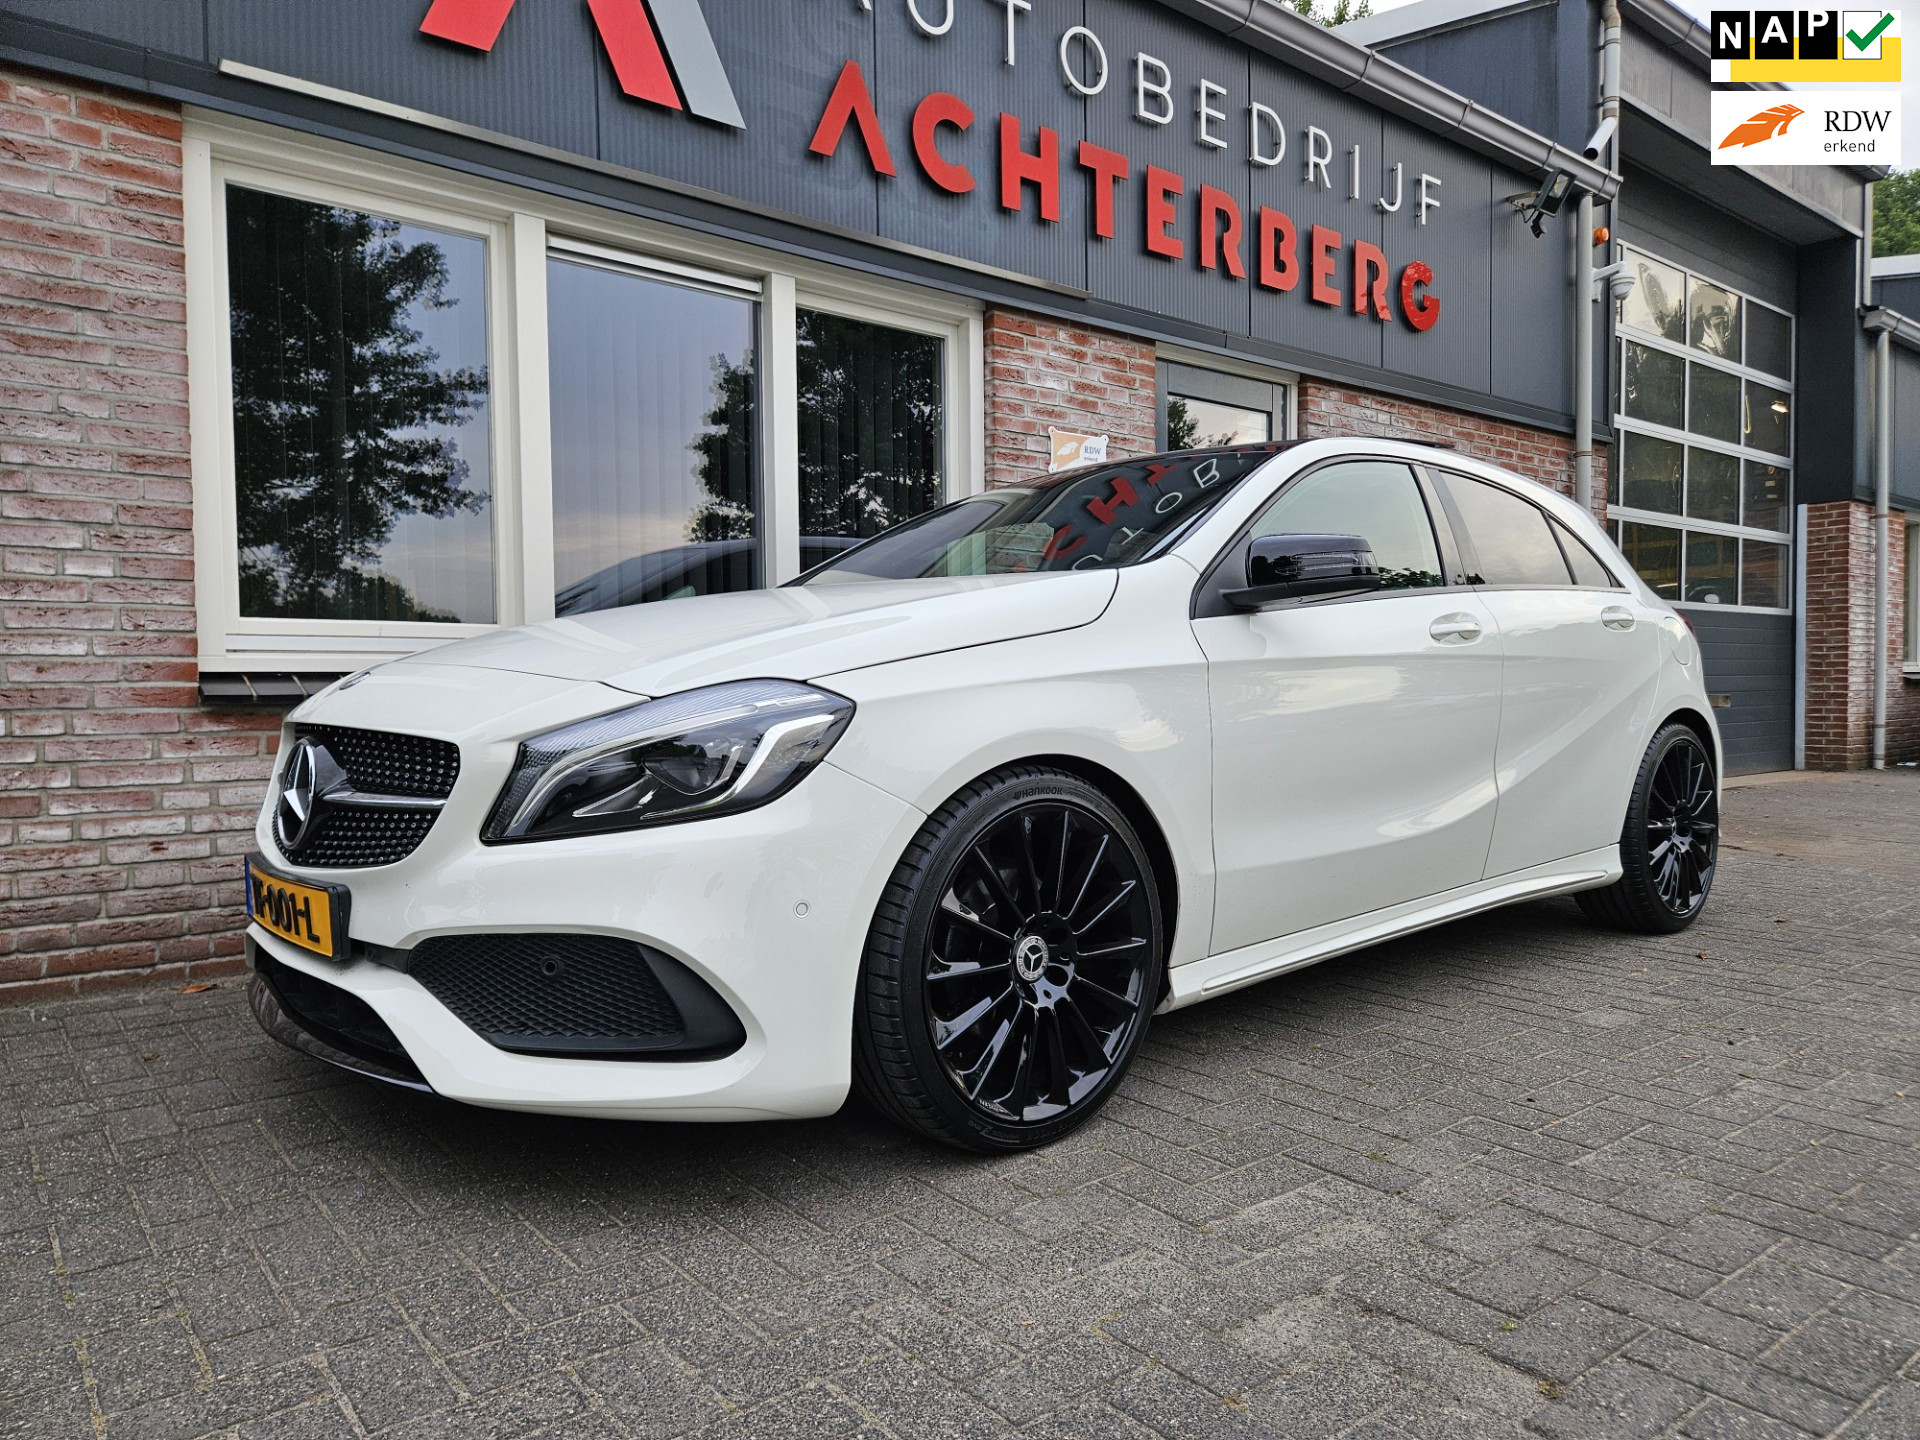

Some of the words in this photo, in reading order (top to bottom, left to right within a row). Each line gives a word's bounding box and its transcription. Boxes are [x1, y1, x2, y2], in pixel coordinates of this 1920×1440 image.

[809, 58, 1440, 332] ACHTERBERG
[860, 0, 1441, 226] TOBEDRIJF
[1084, 445, 1101, 455] RDW
